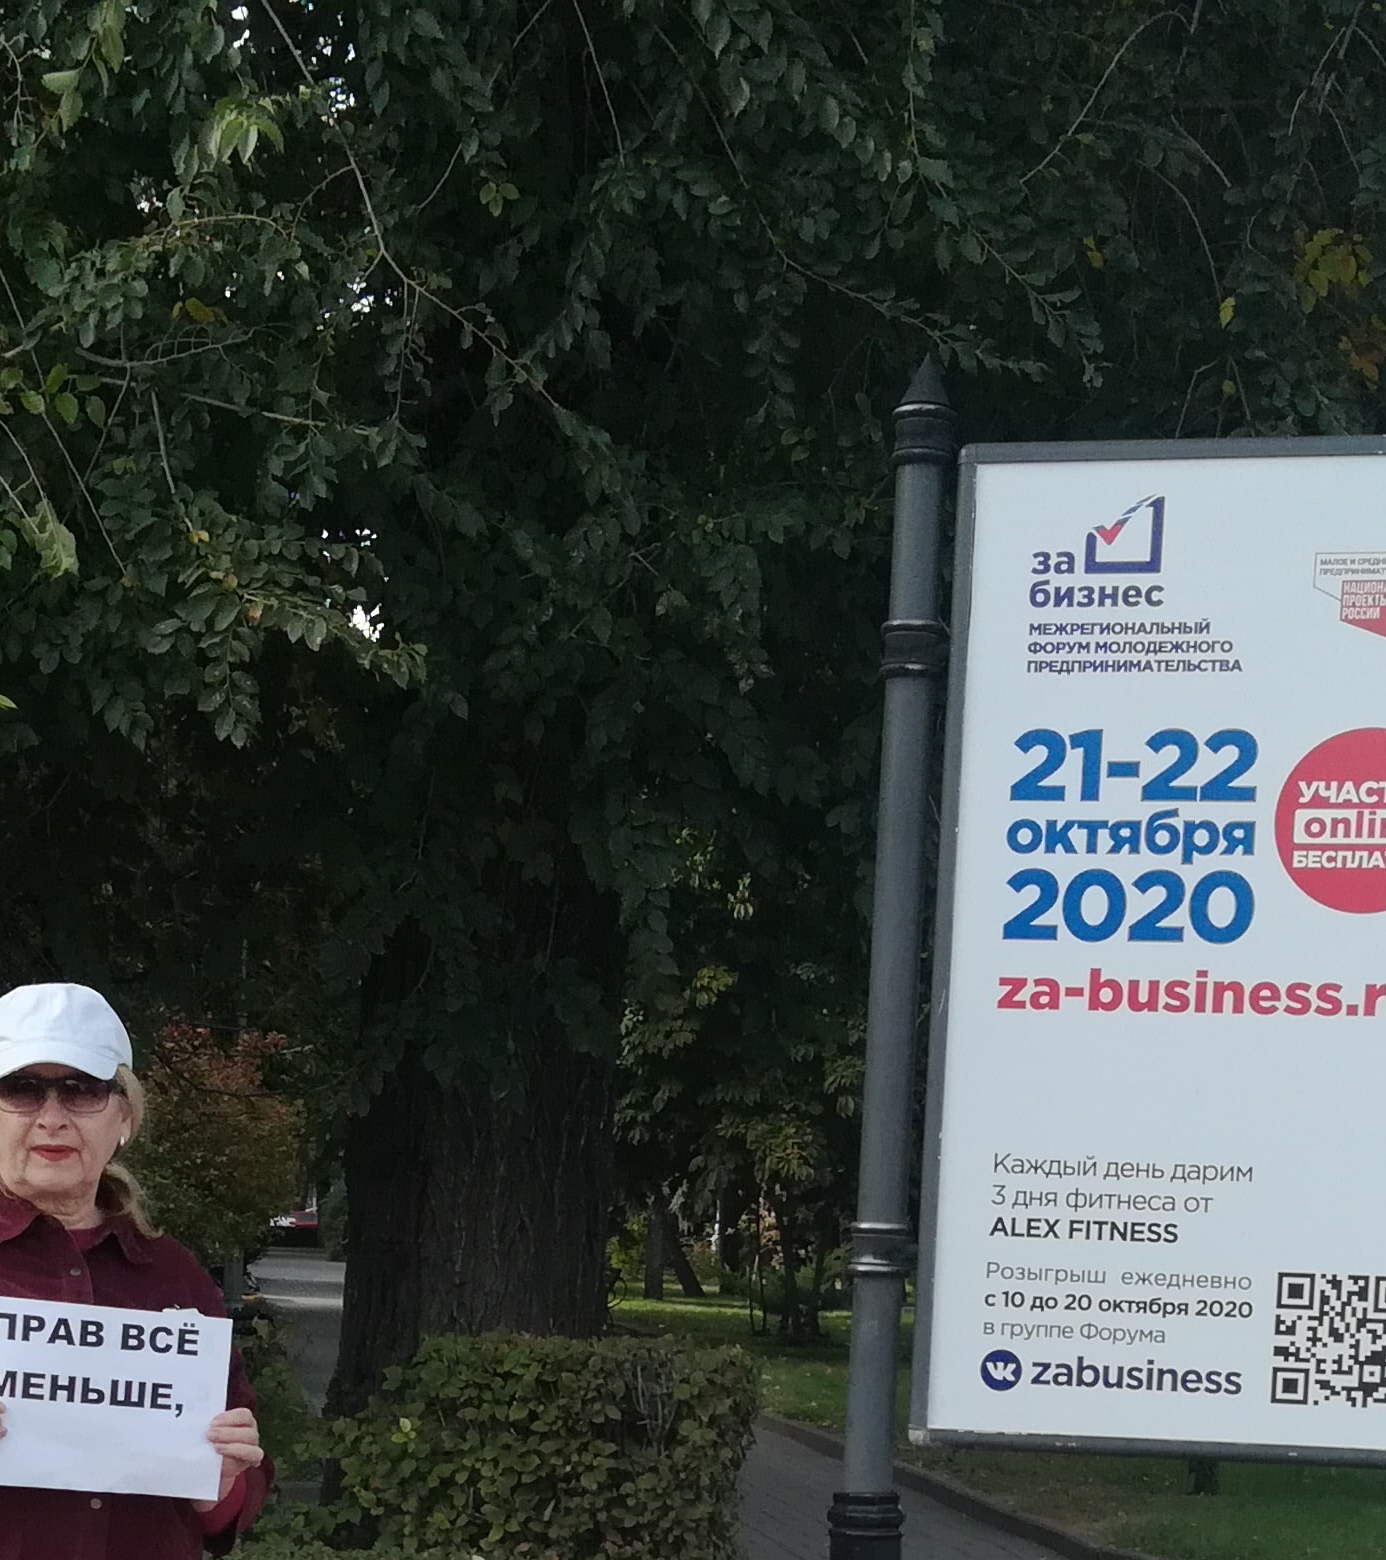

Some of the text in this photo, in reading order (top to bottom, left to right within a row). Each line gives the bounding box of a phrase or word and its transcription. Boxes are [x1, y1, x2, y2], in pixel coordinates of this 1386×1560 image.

[1030, 550, 1075, 575] за
[1319, 557, 1349, 566] МАЛОЕ
[1028, 579, 1165, 608] бизнес
[1028, 617, 1211, 636] МЕЖРЕГИОНАЛЬНЫЙ
[1341, 607, 1380, 620] РОССИИ
[1027, 639, 1233, 656] ФОРУМ МОЛОДЕЖНОГО
[1026, 659, 1243, 675] ПРЕДПРИНИМАТЕЛЬСТВА
[1009, 727, 1259, 803] 21-22
[1006, 807, 1256, 865] октября
[1002, 867, 1255, 944] 2020
[992, 1152, 1254, 1185] Каждый день дарим
[990, 1184, 1214, 1213] 3 дня фитнеса от
[989, 1216, 1179, 1244] ALEX FITNESS
[985, 1261, 1253, 1291] Розыгрыш ежедневно
[984, 1290, 1254, 1318] с 10 до 20 октября 2020
[120, 1321, 201, 1357] ВСЁ
[982, 1321, 1166, 1345] в группе Форума
[1030, 1356, 1243, 1396] zabusiness
